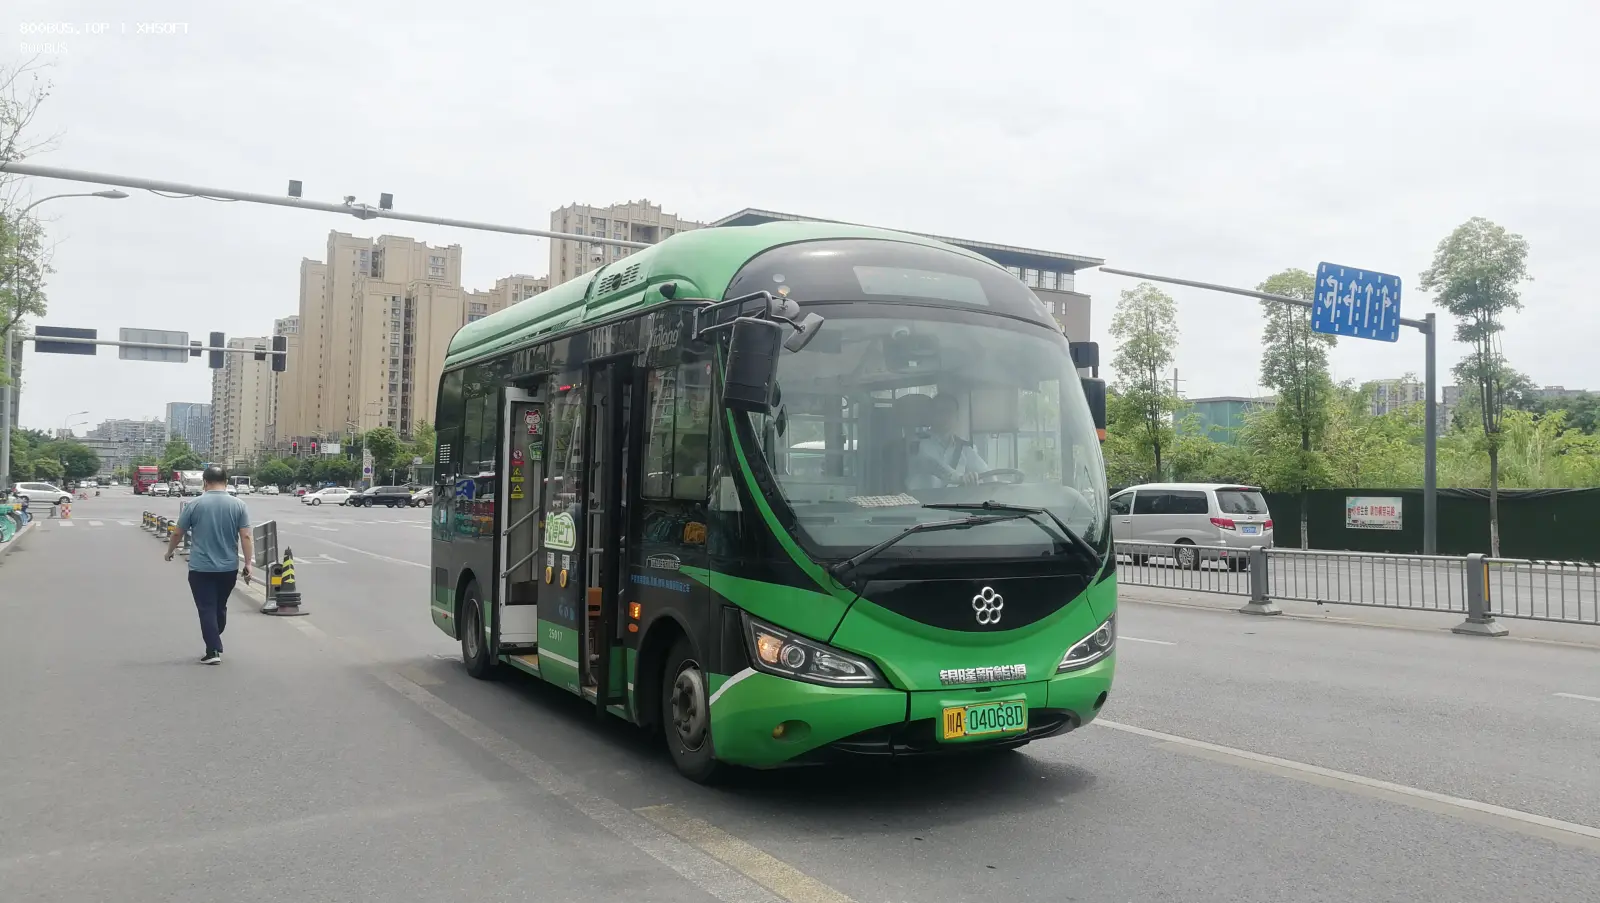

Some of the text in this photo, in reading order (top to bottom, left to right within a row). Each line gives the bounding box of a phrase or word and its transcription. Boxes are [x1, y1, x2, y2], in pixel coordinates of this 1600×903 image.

[940, 664, 1027, 685] 银隆新能源
[946, 705, 1024, 734] 川A 04068D
